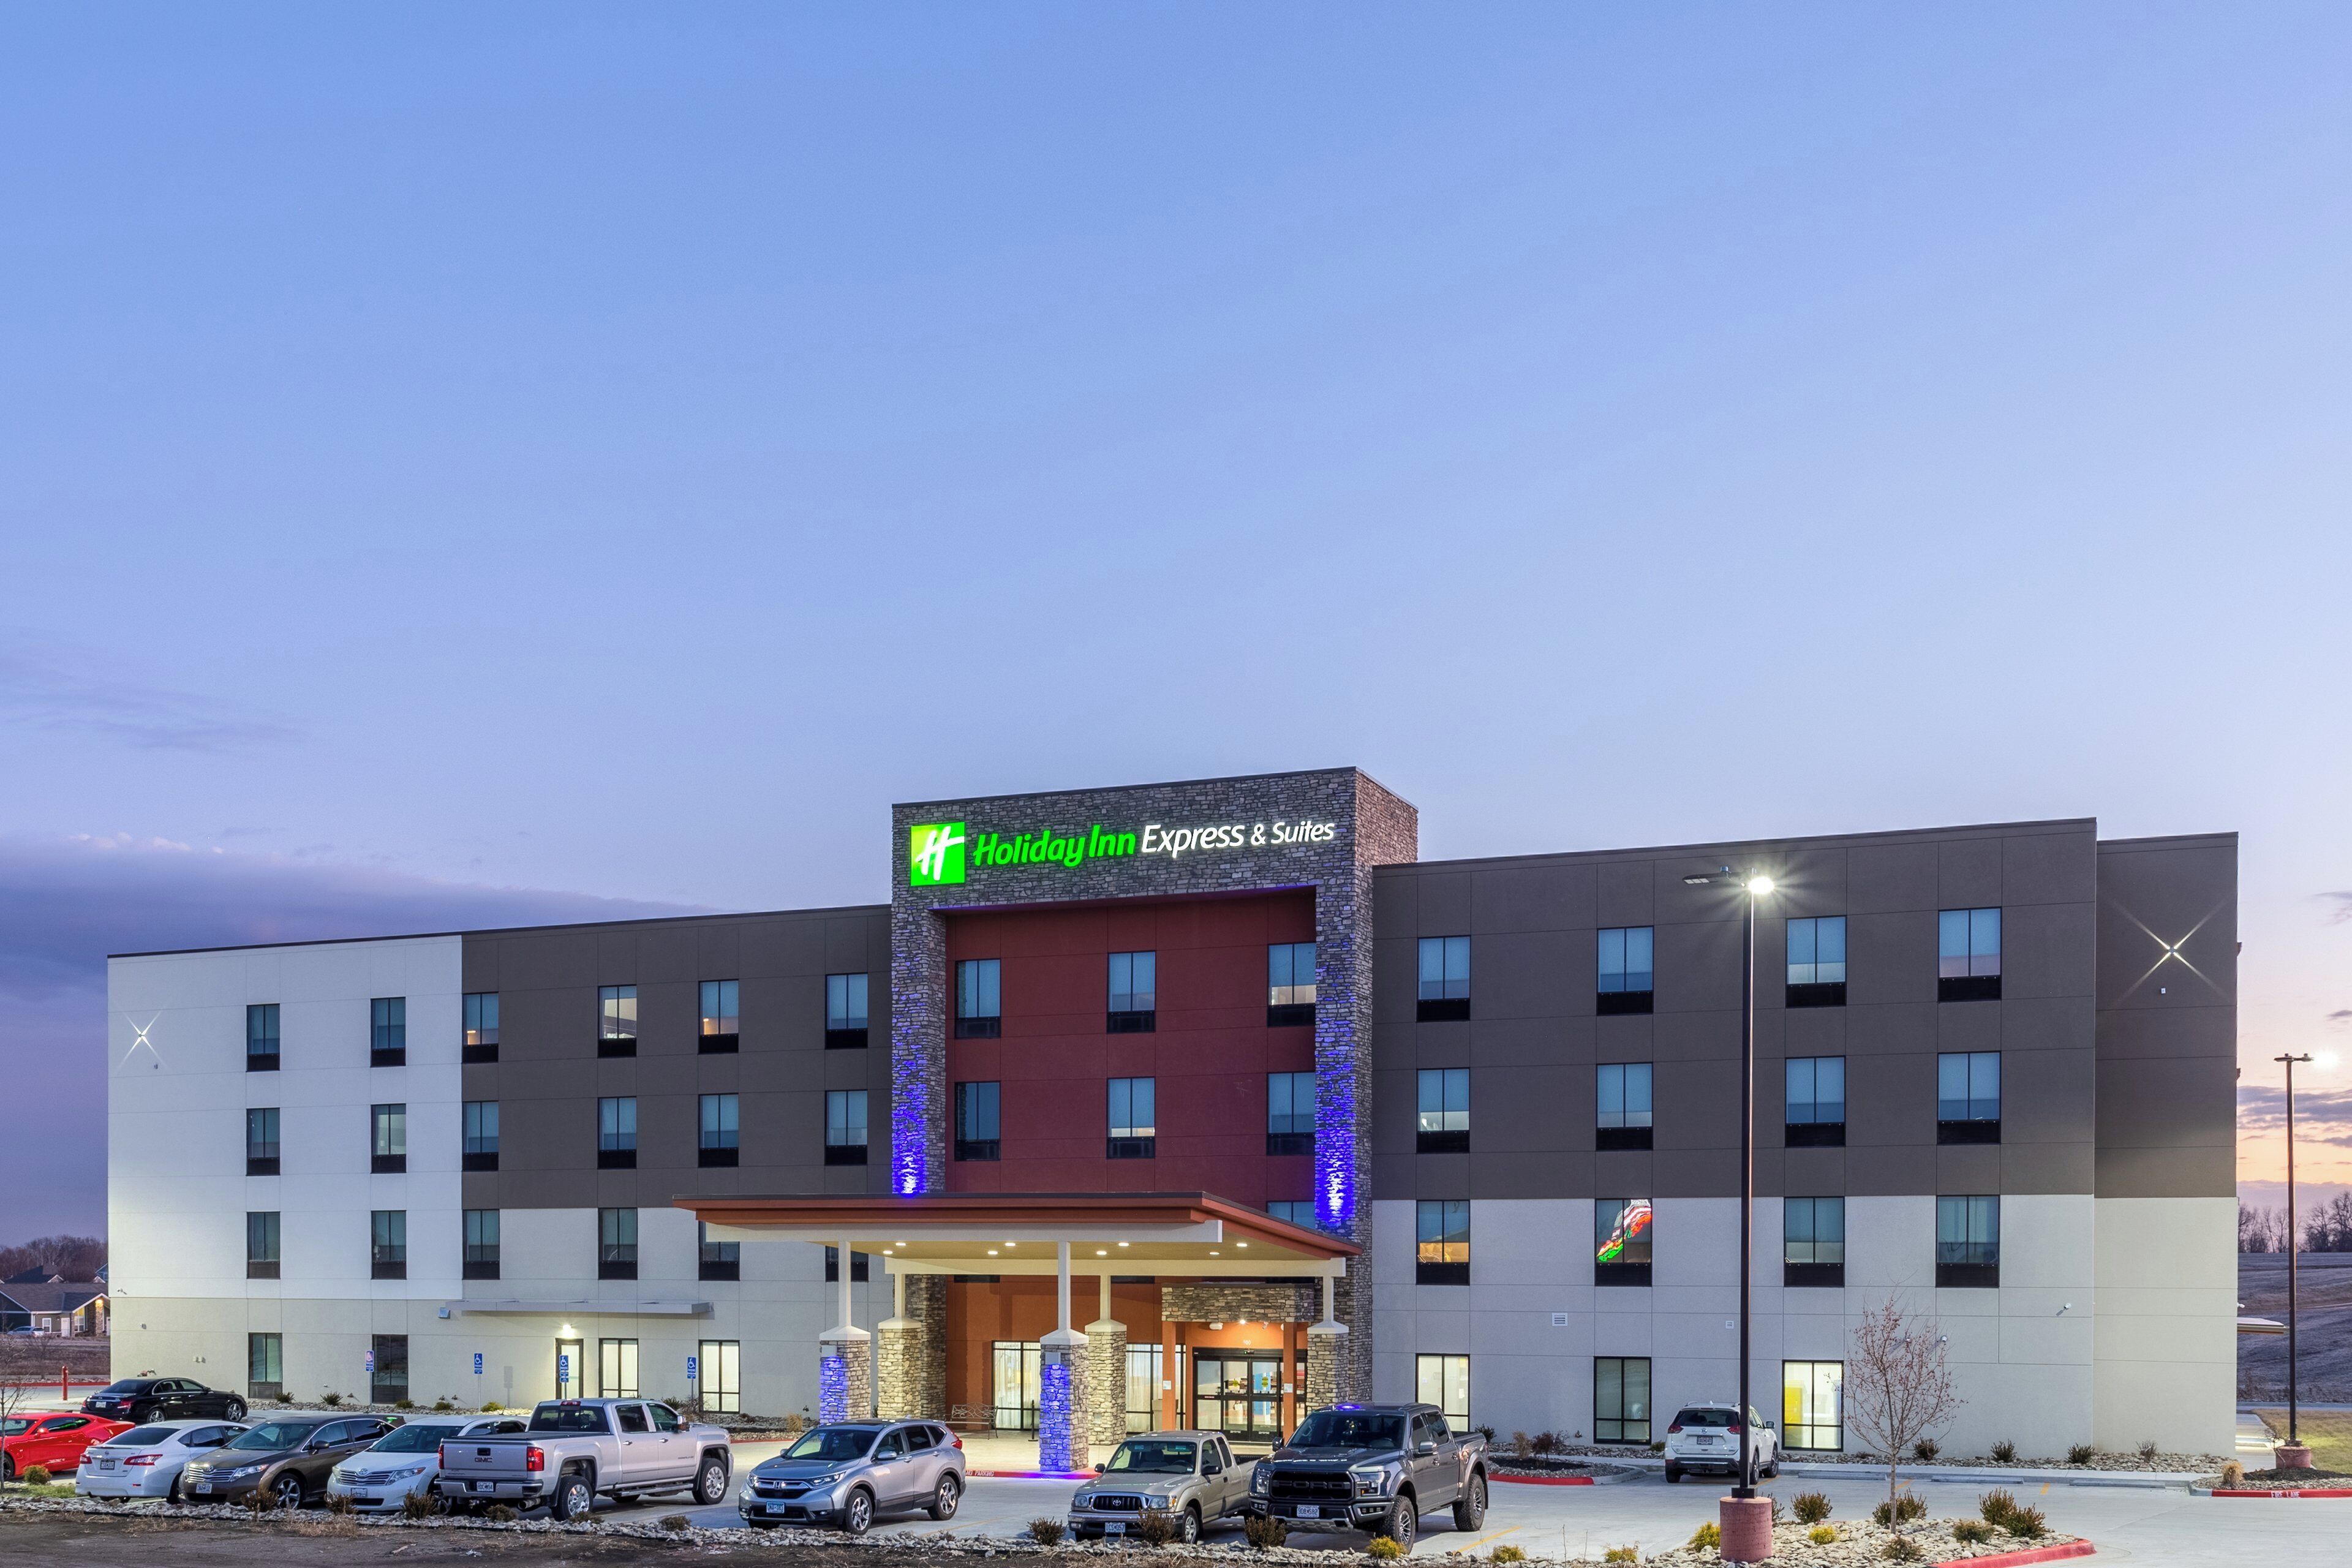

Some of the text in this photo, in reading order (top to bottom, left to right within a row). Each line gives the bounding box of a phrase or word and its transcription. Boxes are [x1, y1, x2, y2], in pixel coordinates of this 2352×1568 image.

[972, 820, 1335, 867] Holiday Inn Express & Suites
